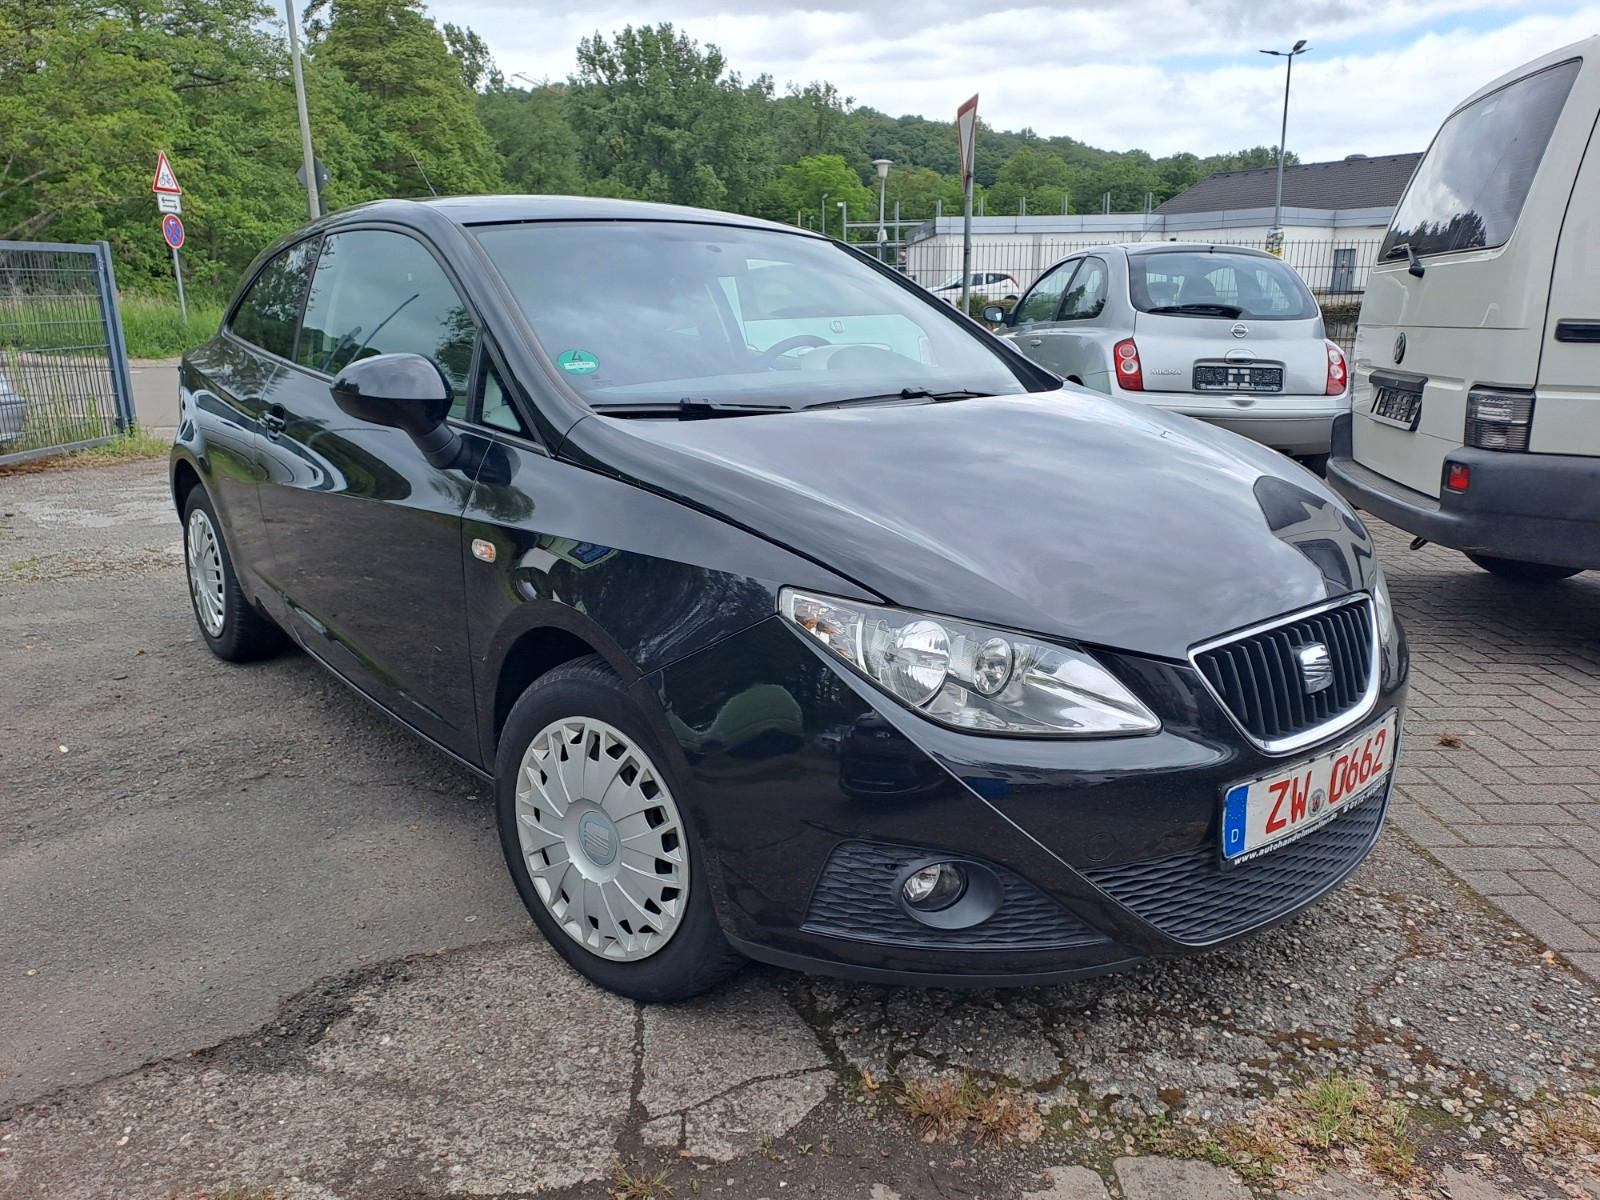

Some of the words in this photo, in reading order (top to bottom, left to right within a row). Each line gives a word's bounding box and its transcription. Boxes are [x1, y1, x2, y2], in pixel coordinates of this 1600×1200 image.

[1265, 770, 1312, 834] ZW
[1328, 728, 1386, 804] 0662
[1231, 828, 1239, 843] D
